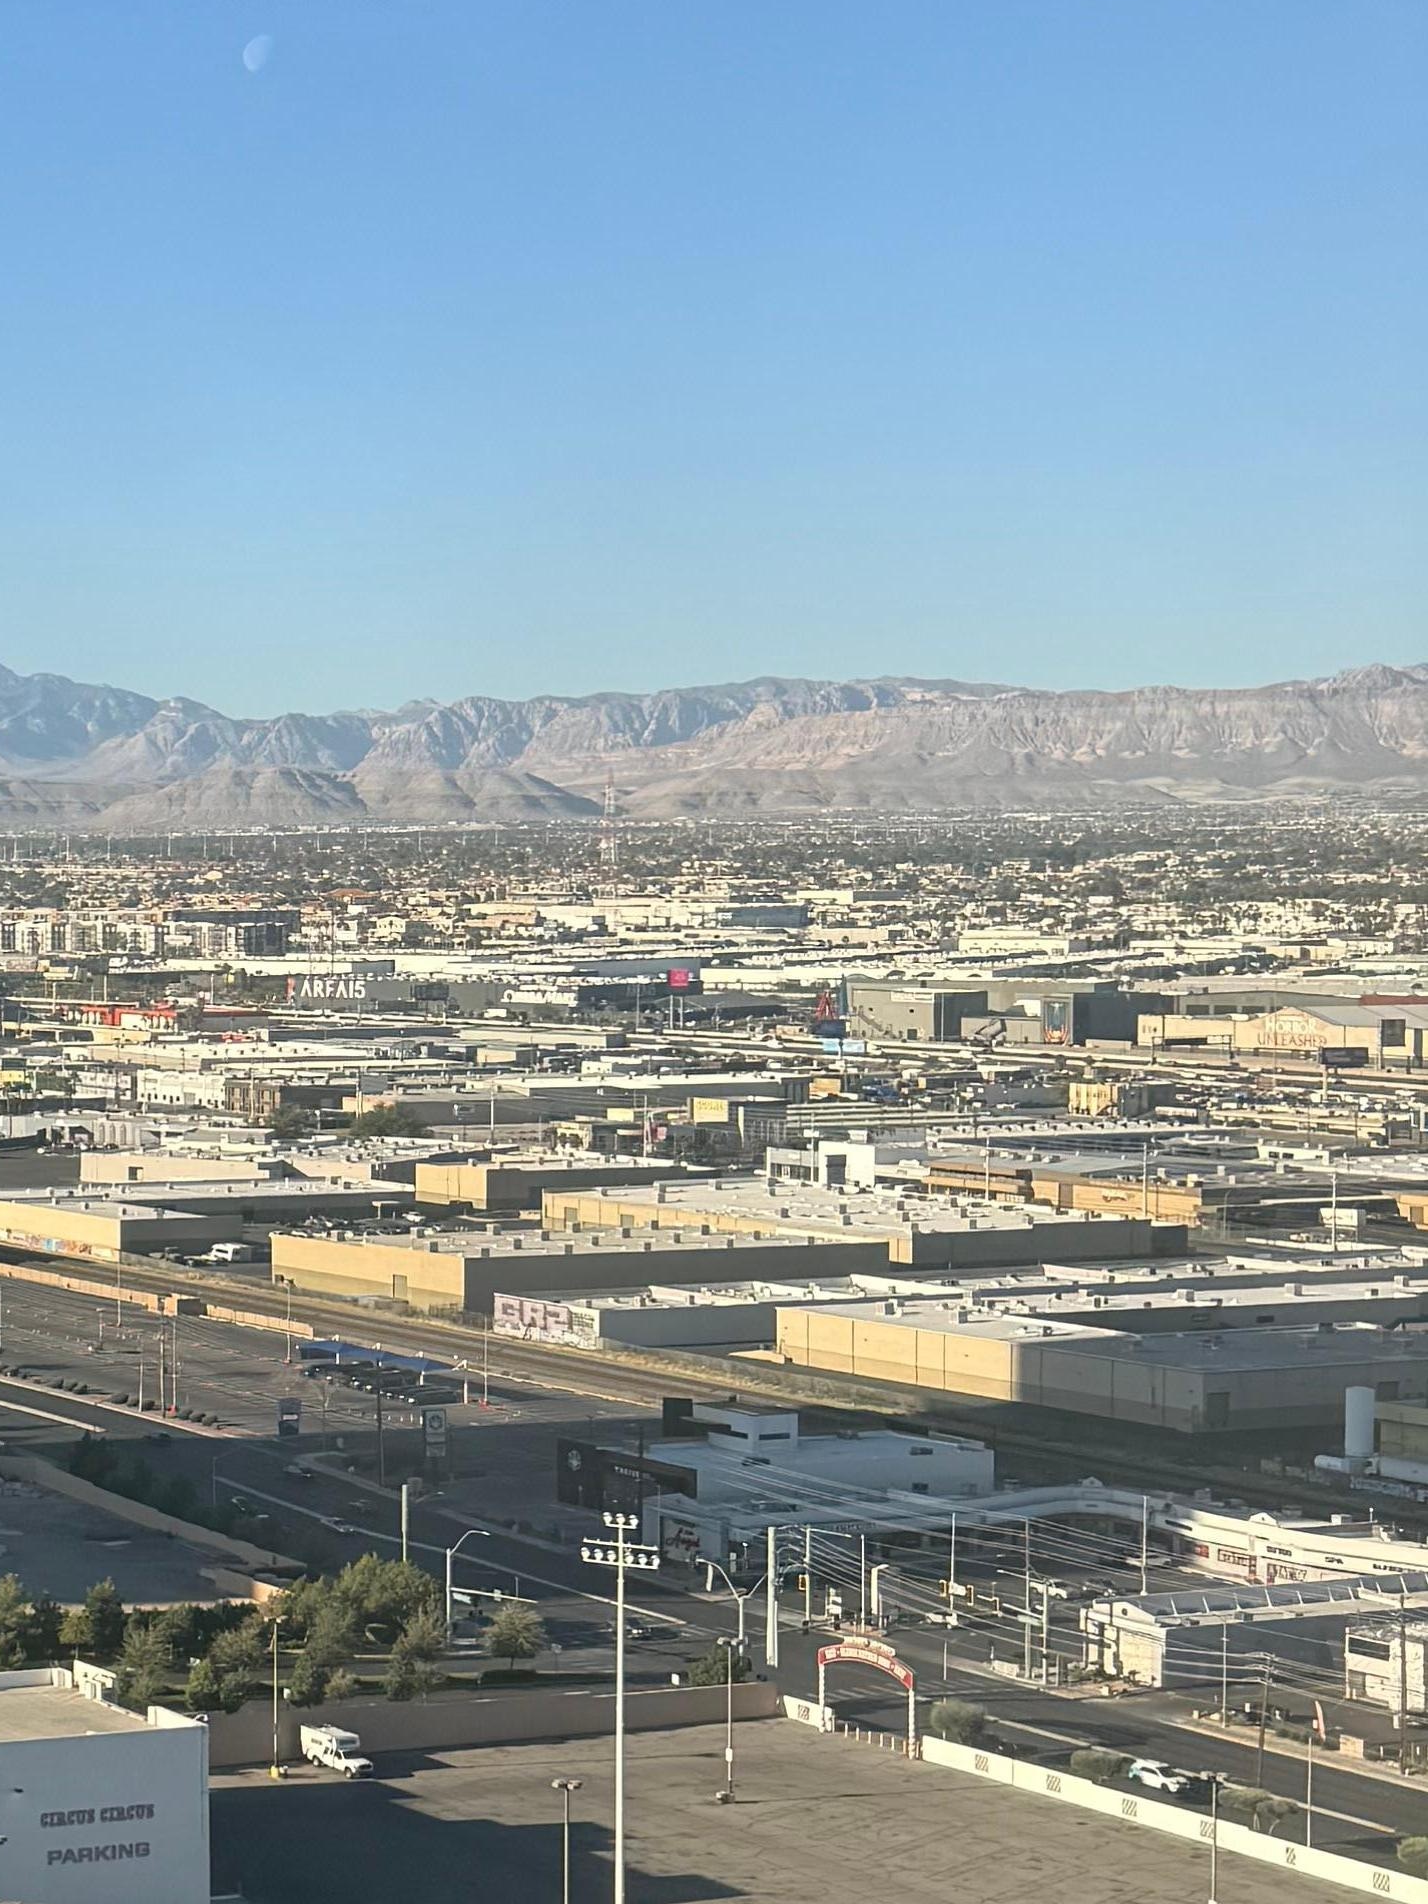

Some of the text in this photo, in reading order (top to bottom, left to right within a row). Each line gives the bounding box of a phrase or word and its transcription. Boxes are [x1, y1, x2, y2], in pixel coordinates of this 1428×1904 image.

[40, 1804, 155, 1828] CIRCUS CIRCUS
[47, 1842, 151, 1866] PARKING
